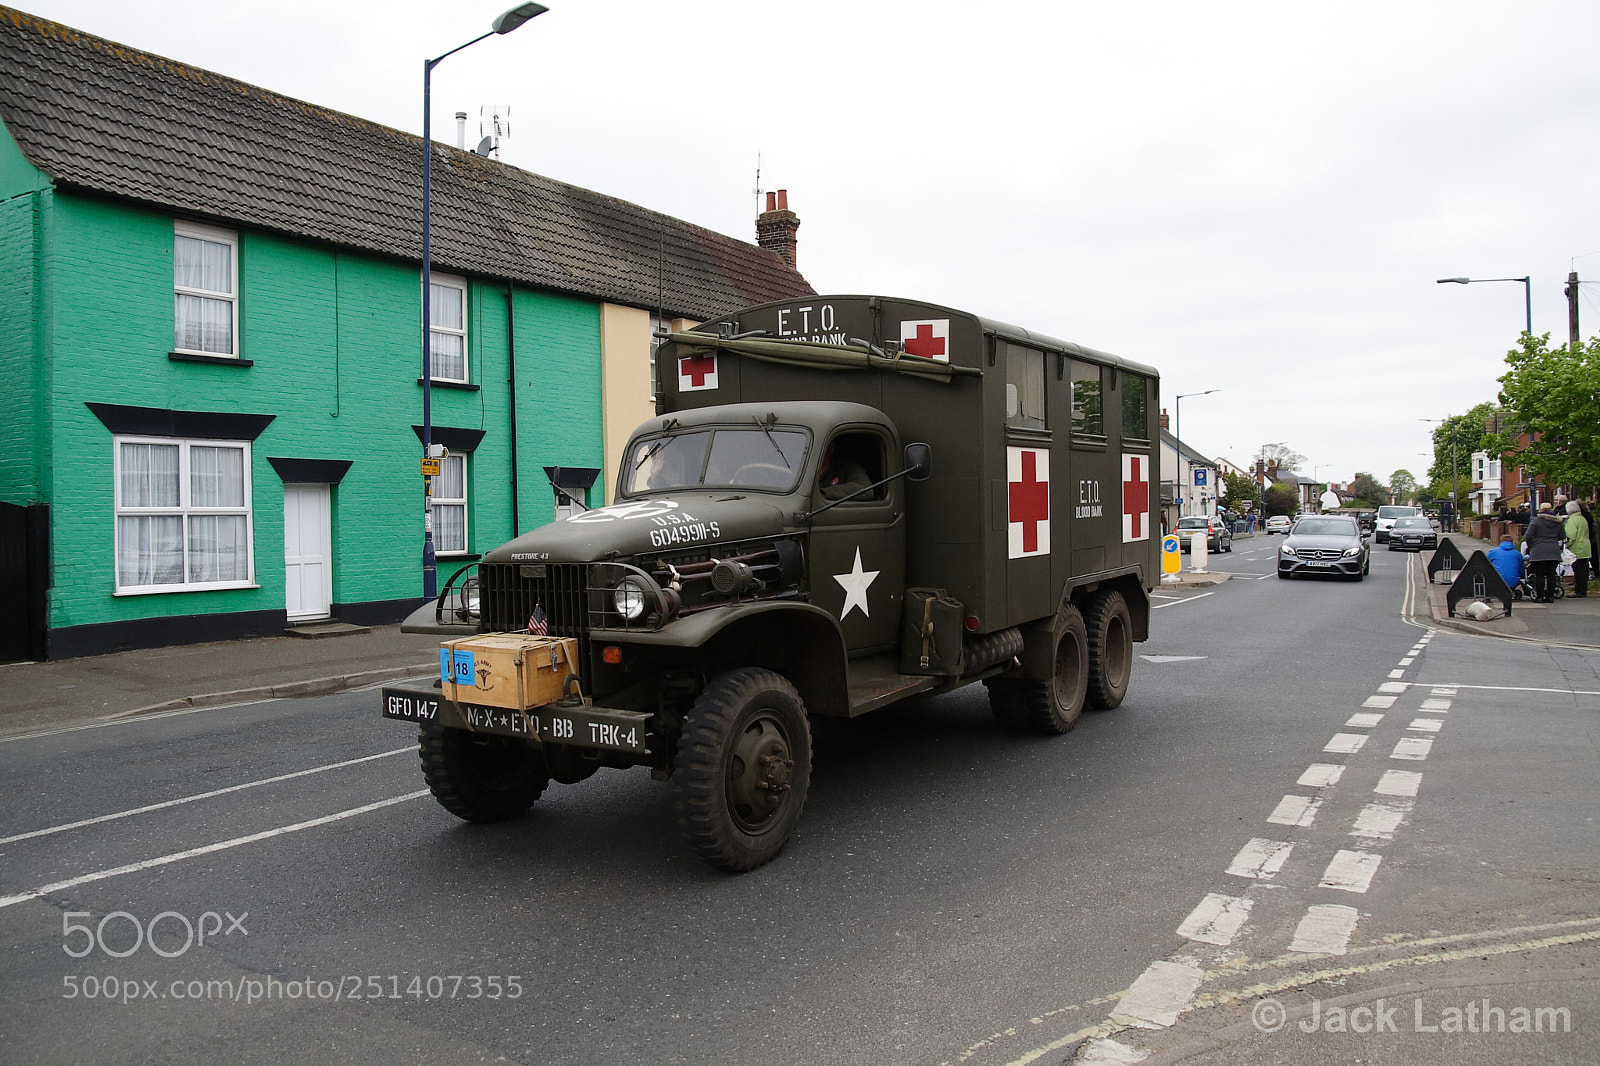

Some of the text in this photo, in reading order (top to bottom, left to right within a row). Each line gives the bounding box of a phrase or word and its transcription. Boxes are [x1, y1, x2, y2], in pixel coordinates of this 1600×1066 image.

[778, 304, 840, 336] E.T.O.
[388, 696, 438, 720] GFO 147
[588, 722, 639, 748] TRK-4
